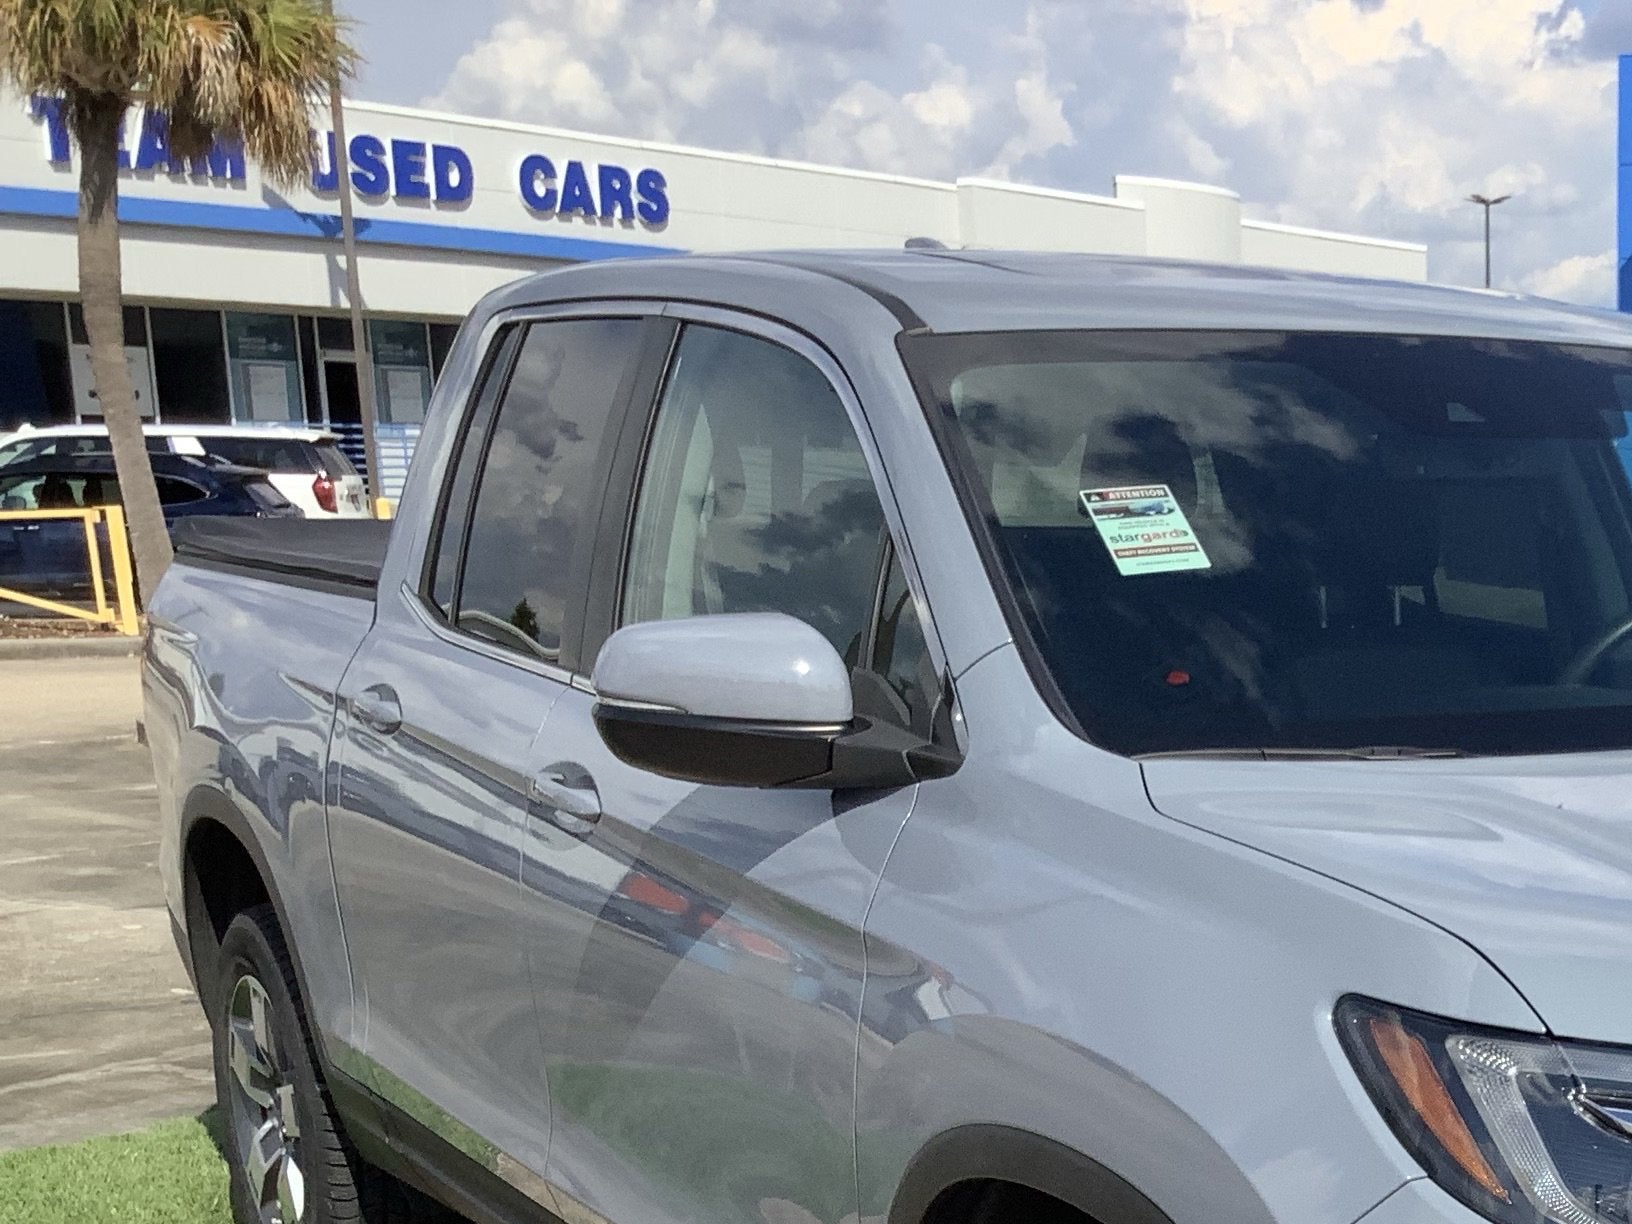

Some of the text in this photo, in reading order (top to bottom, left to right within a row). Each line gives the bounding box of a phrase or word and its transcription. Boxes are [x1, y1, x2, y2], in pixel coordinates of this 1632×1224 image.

[309, 128, 473, 202] USED
[519, 154, 670, 224] CARS
[1108, 488, 1165, 500] ATTENTION
